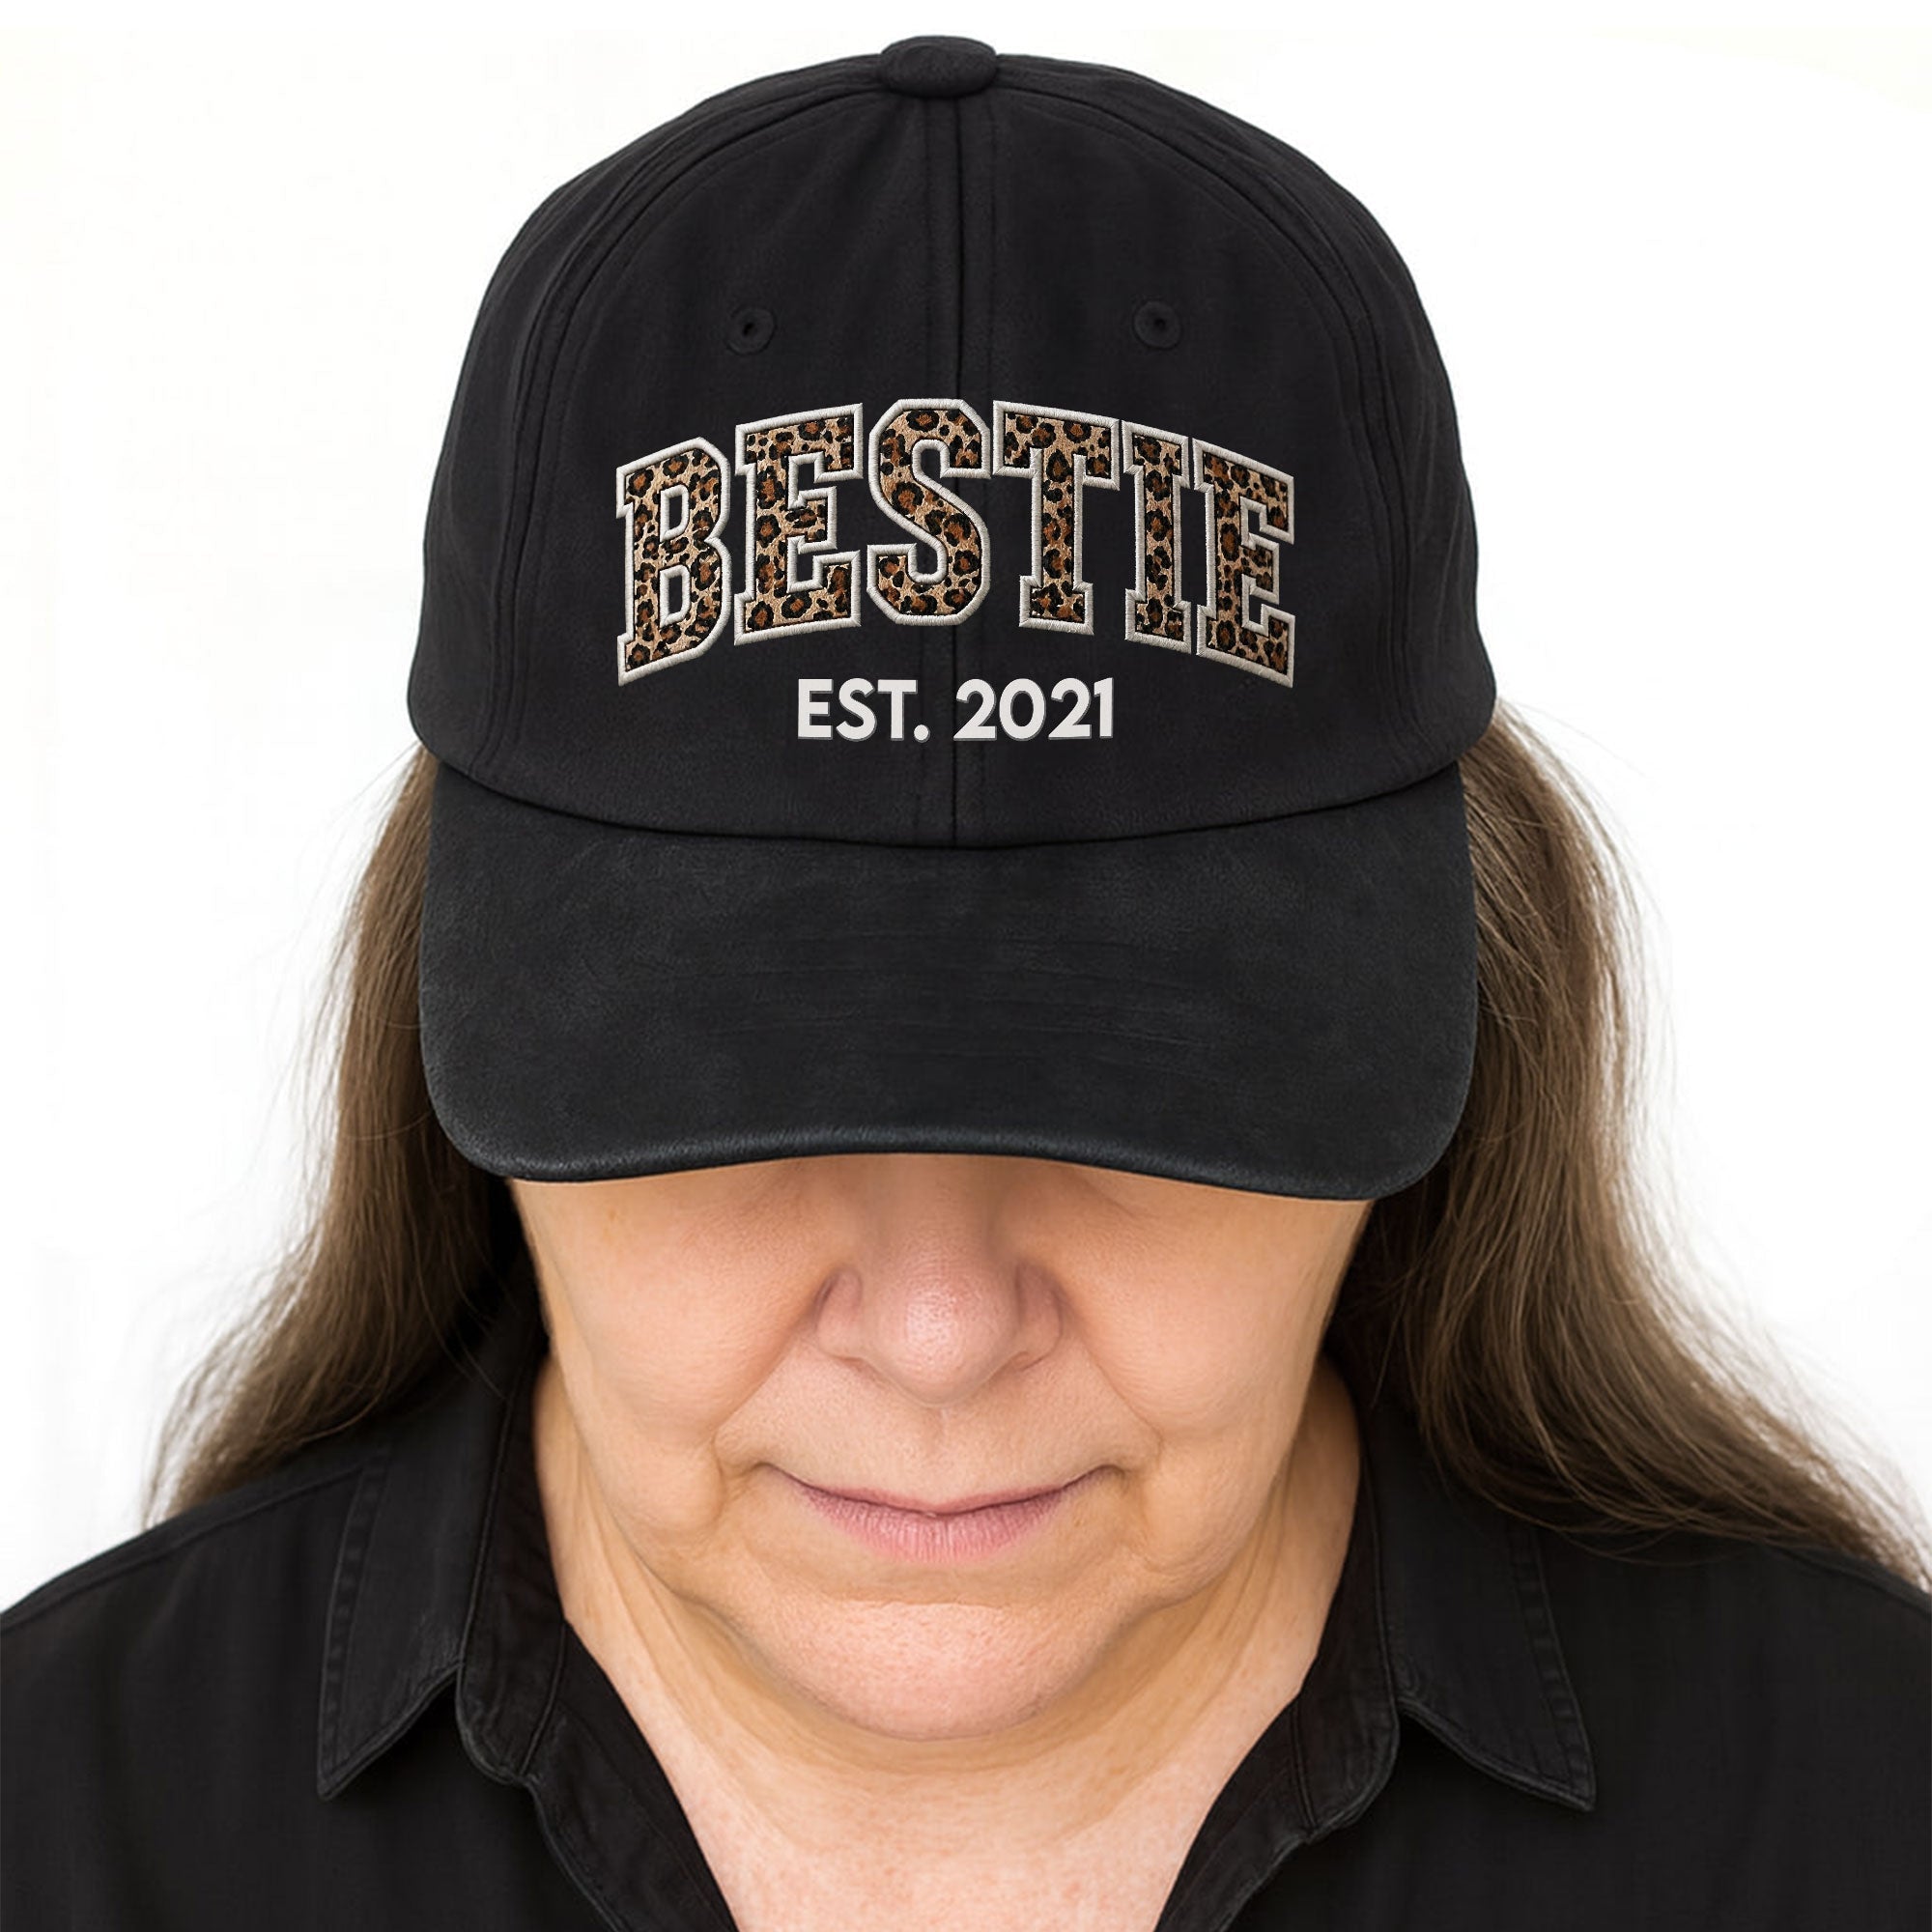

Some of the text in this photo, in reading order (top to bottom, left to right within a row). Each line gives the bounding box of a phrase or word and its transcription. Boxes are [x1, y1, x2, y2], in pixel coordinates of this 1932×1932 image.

[615, 397, 1296, 686] BESTIE
[798, 678, 1116, 742] EST. 2021
